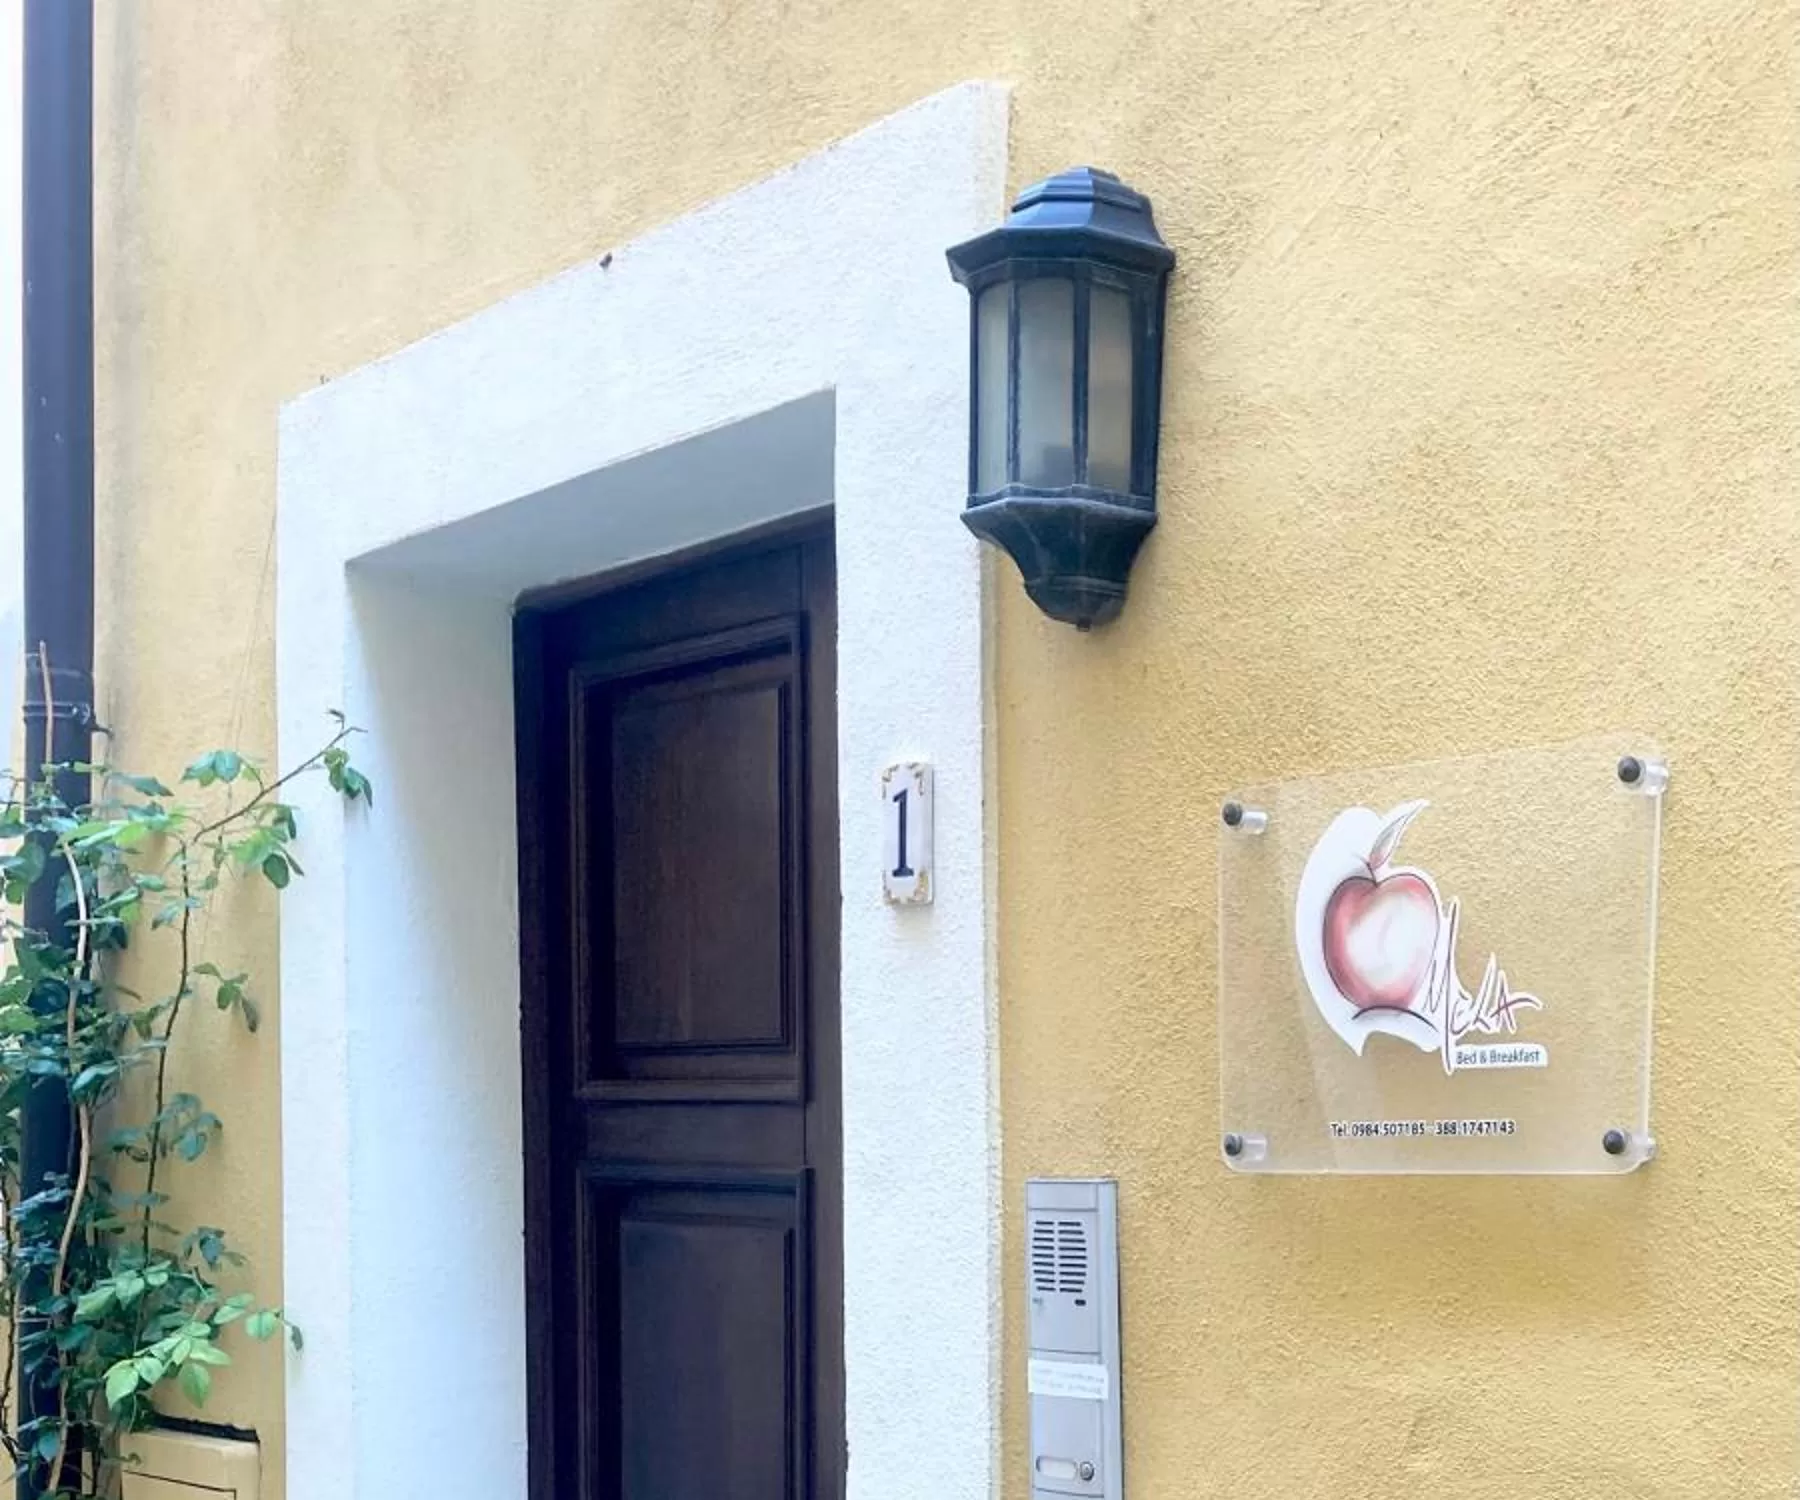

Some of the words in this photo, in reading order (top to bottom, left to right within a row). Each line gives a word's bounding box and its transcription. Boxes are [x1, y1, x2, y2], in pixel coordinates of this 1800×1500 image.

[892, 788, 915, 877] 1
[1456, 1050, 1477, 1065] Bed
[1479, 1049, 1488, 1064] &
[1489, 1048, 1541, 1063] Breakfast
